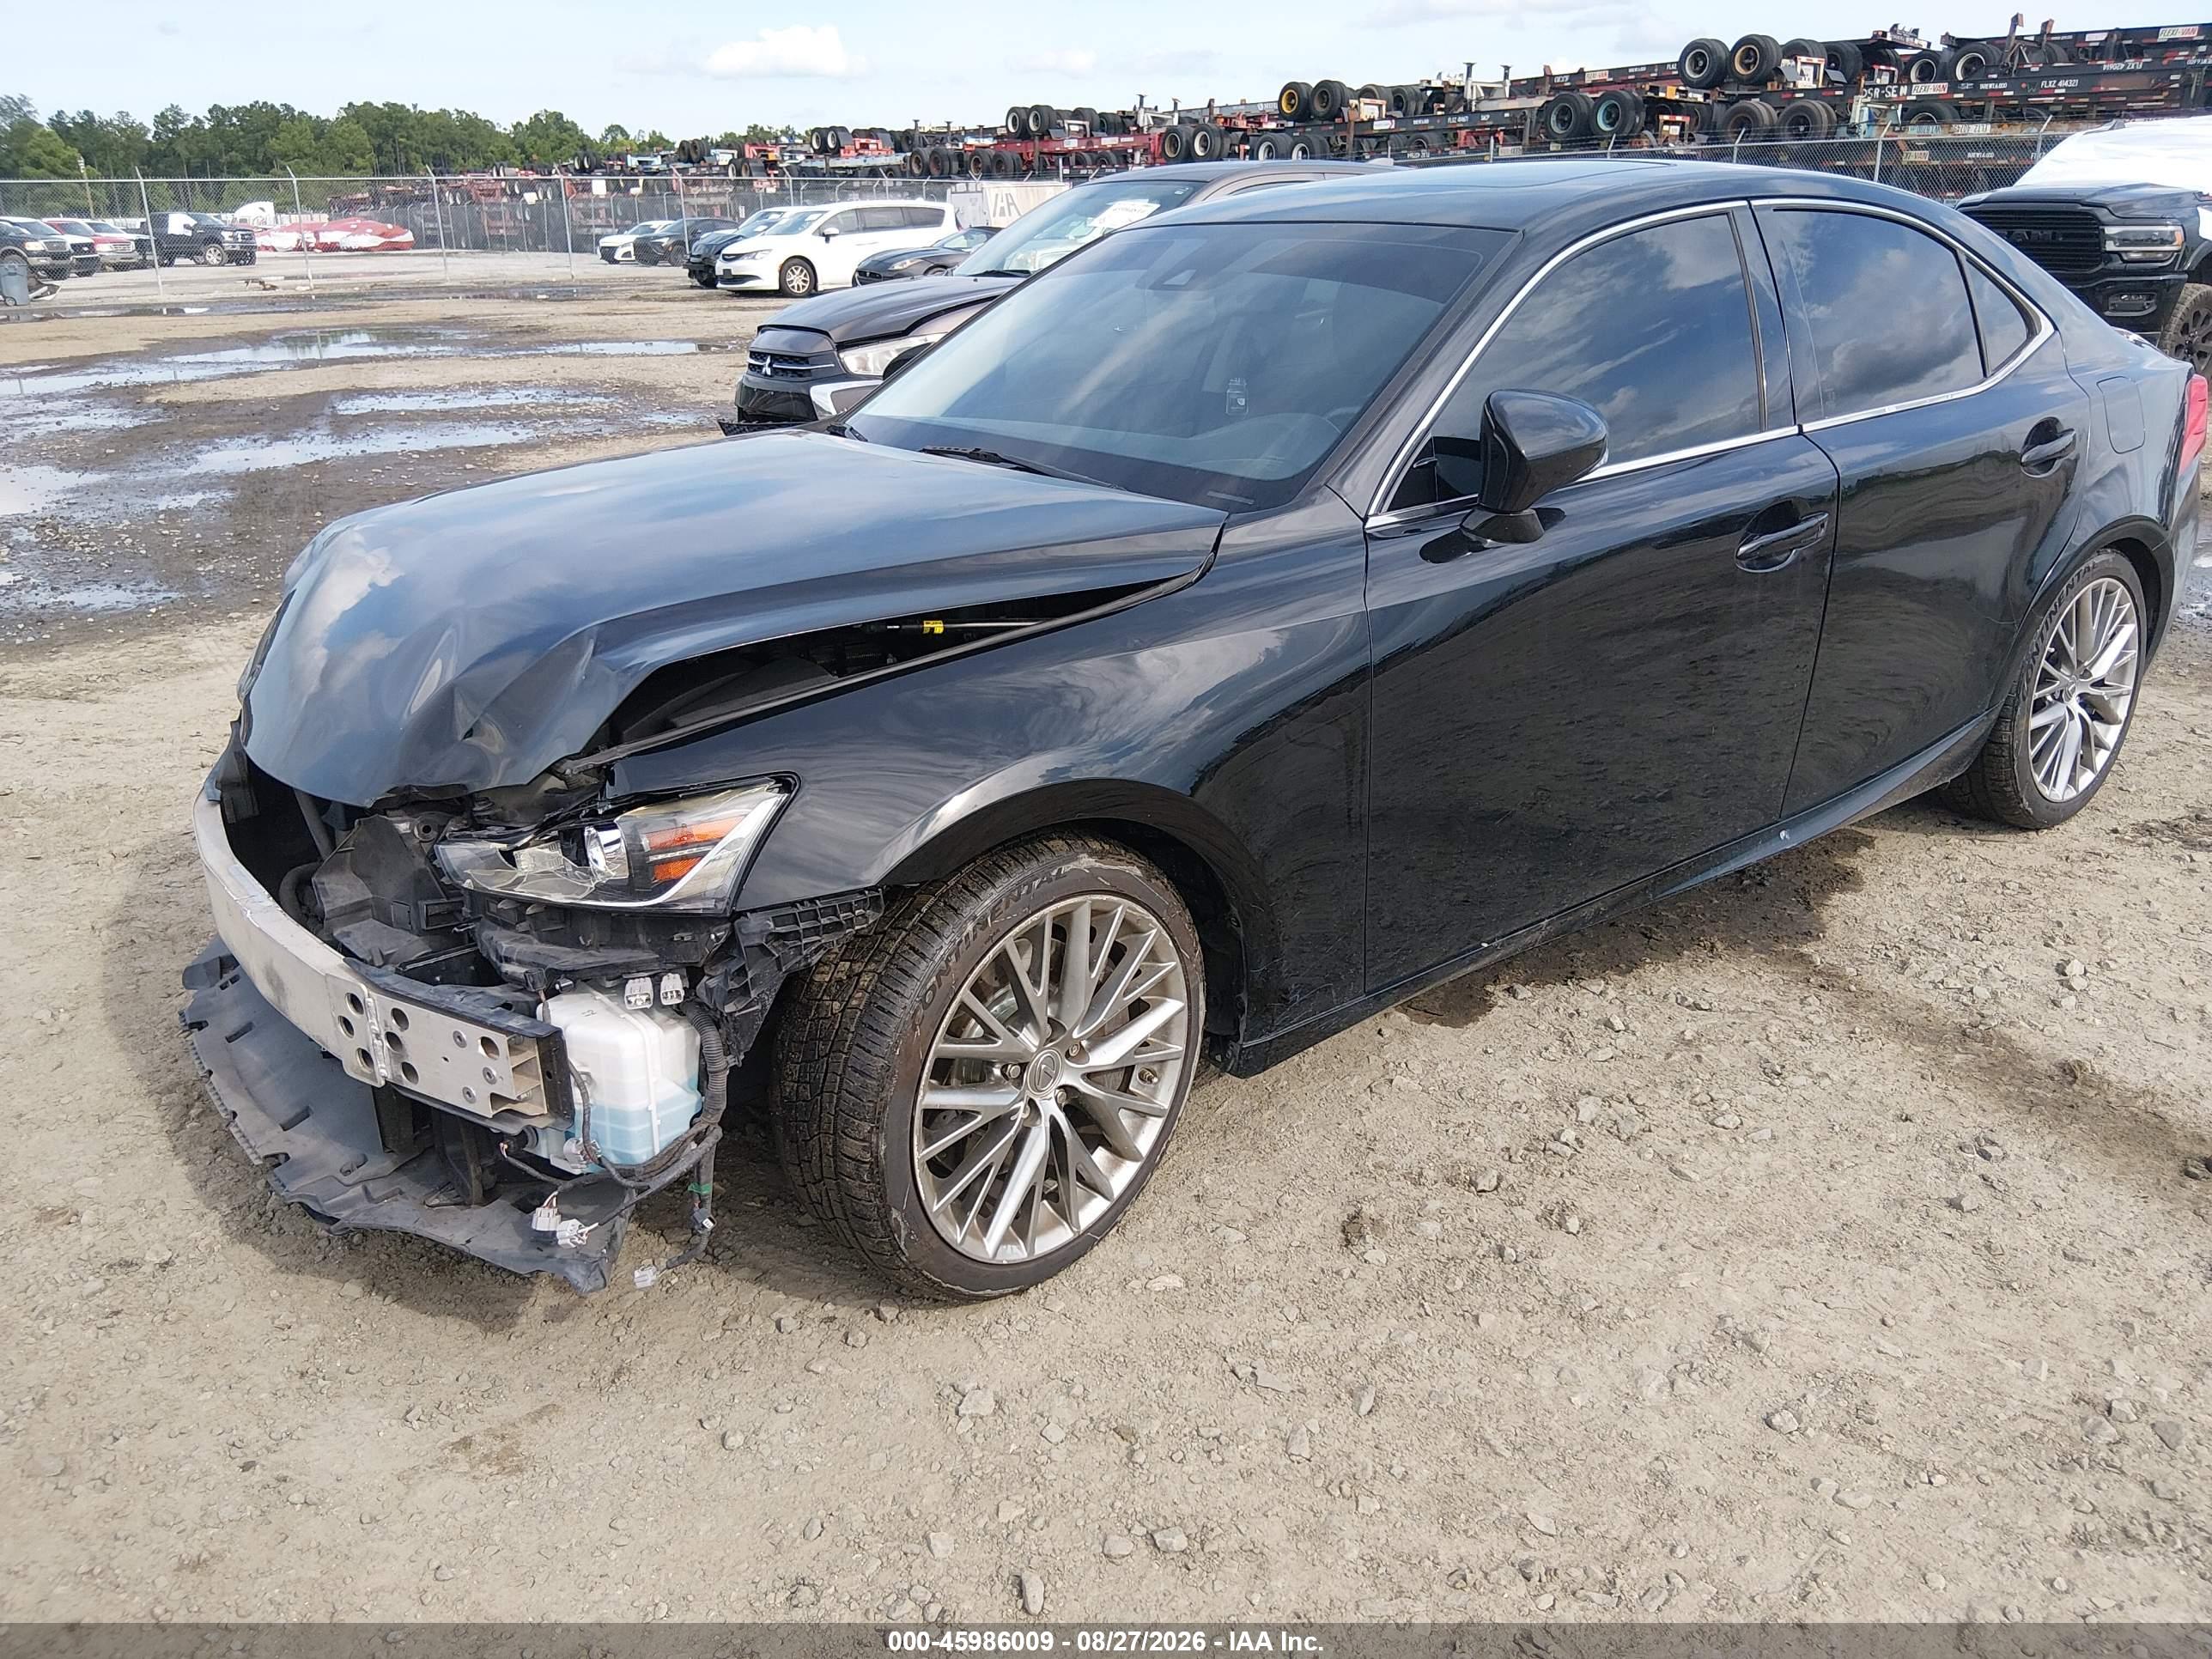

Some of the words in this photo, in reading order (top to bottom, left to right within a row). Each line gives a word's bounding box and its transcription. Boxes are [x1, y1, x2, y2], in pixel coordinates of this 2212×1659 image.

[2160, 27, 2197, 37] FLEXI-VAN
[1912, 83, 1948, 94] FLEXI-VAN
[2040, 80, 2057, 88] FLXZ
[2057, 79, 2079, 88] 414321
[2020, 560, 2098, 702] CONTINENTAL
